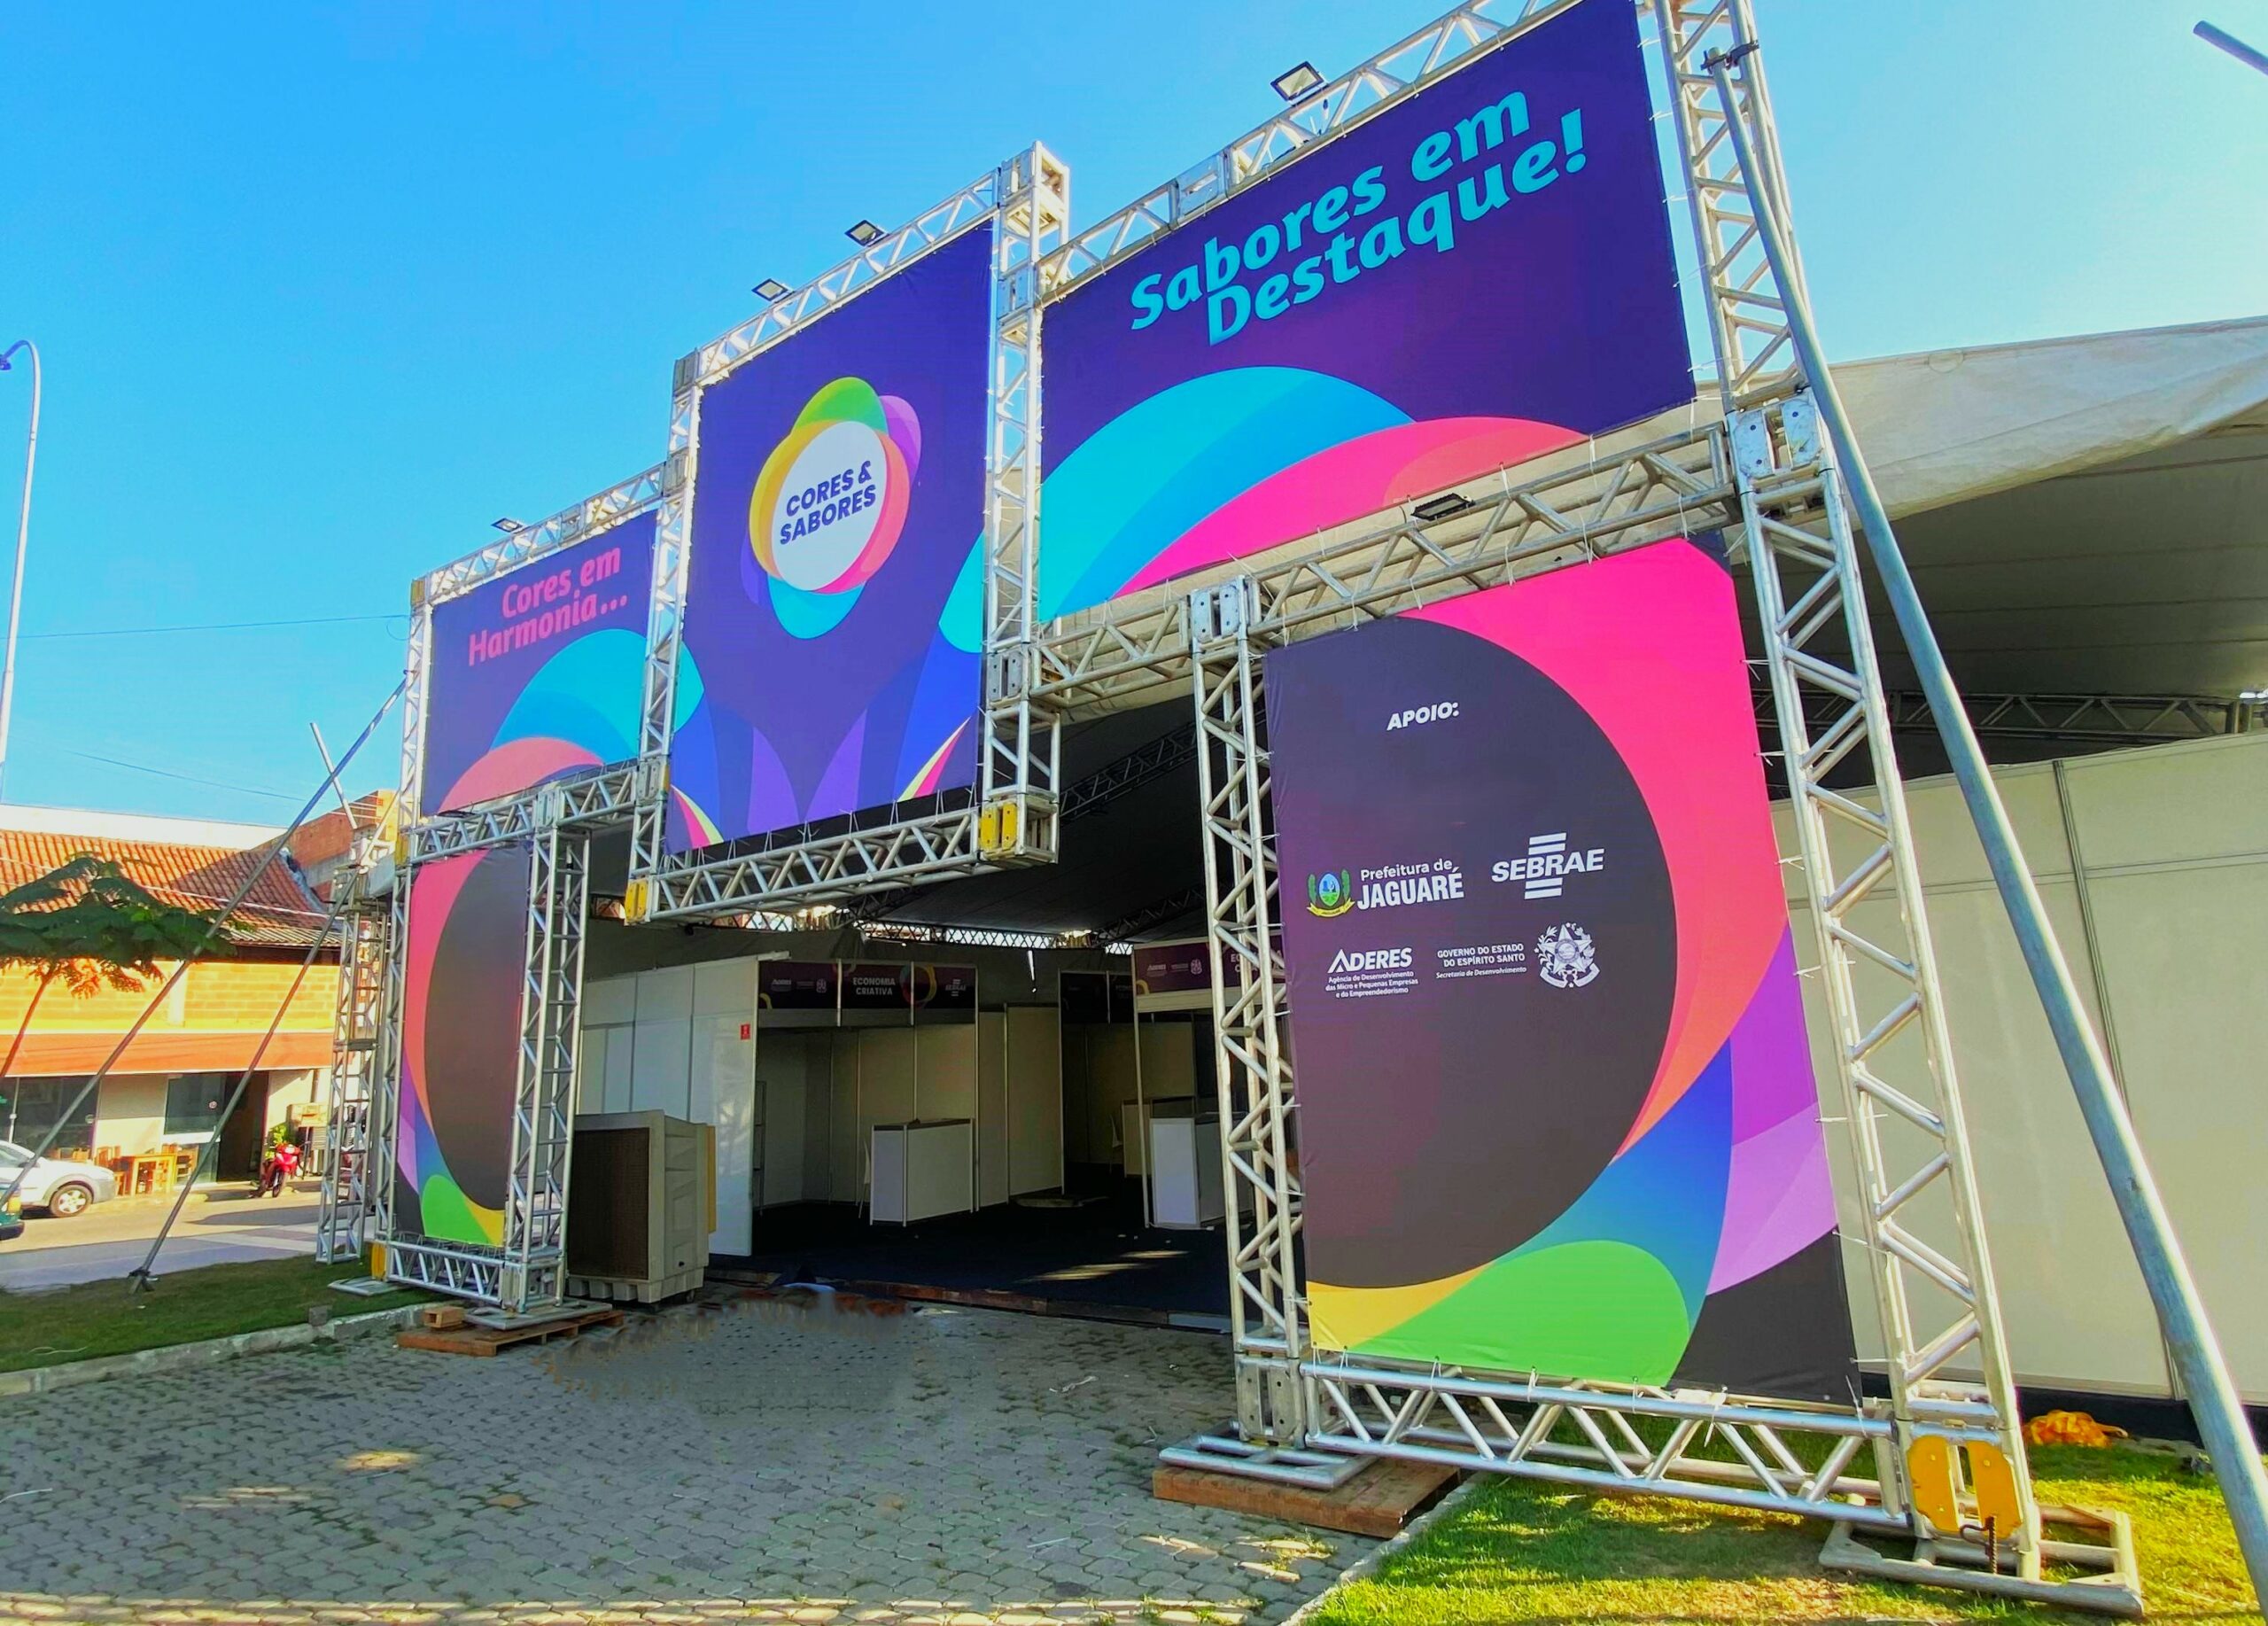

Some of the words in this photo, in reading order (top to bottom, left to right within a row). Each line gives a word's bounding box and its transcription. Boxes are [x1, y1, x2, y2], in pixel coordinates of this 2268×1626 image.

[1130, 165, 1386, 330] Sabores
[1410, 90, 1530, 182] em
[1207, 108, 1587, 346] Destaque!
[786, 469, 854, 517] CORES
[858, 460, 872, 484] &
[780, 484, 876, 545] SABORES
[501, 568, 571, 619] Cores
[579, 545, 621, 588] em
[468, 589, 627, 666] Harmonia...
[1386, 702, 1459, 731] APOIO:
[1361, 862, 1430, 882] Prefeitura
[1433, 858, 1453, 872] de
[1491, 848, 1604, 883] SEBRAE
[1357, 867, 1464, 910] JAGUARÉ
[1327, 947, 1413, 974] ADERES
[1437, 947, 1476, 959] GOVERNO
[1477, 945, 1489, 954] DO
[1492, 943, 1524, 953] ESTADO
[1443, 959, 1456, 968] DO
[1457, 955, 1495, 967] ESPÍRITO
[1496, 953, 1526, 963] SANTO
[852, 976, 897, 986] ECONOMIA
[1359, 980, 1388, 990] Pequenas
[1388, 978, 1418, 987] Empresas
[1361, 970, 1414, 981] Desenvolvimento
[1474, 966, 1527, 976] Desenvolvimento
[855, 986, 893, 996] CRIATIVA
[1349, 987, 1409, 998] Empreendedorismo
